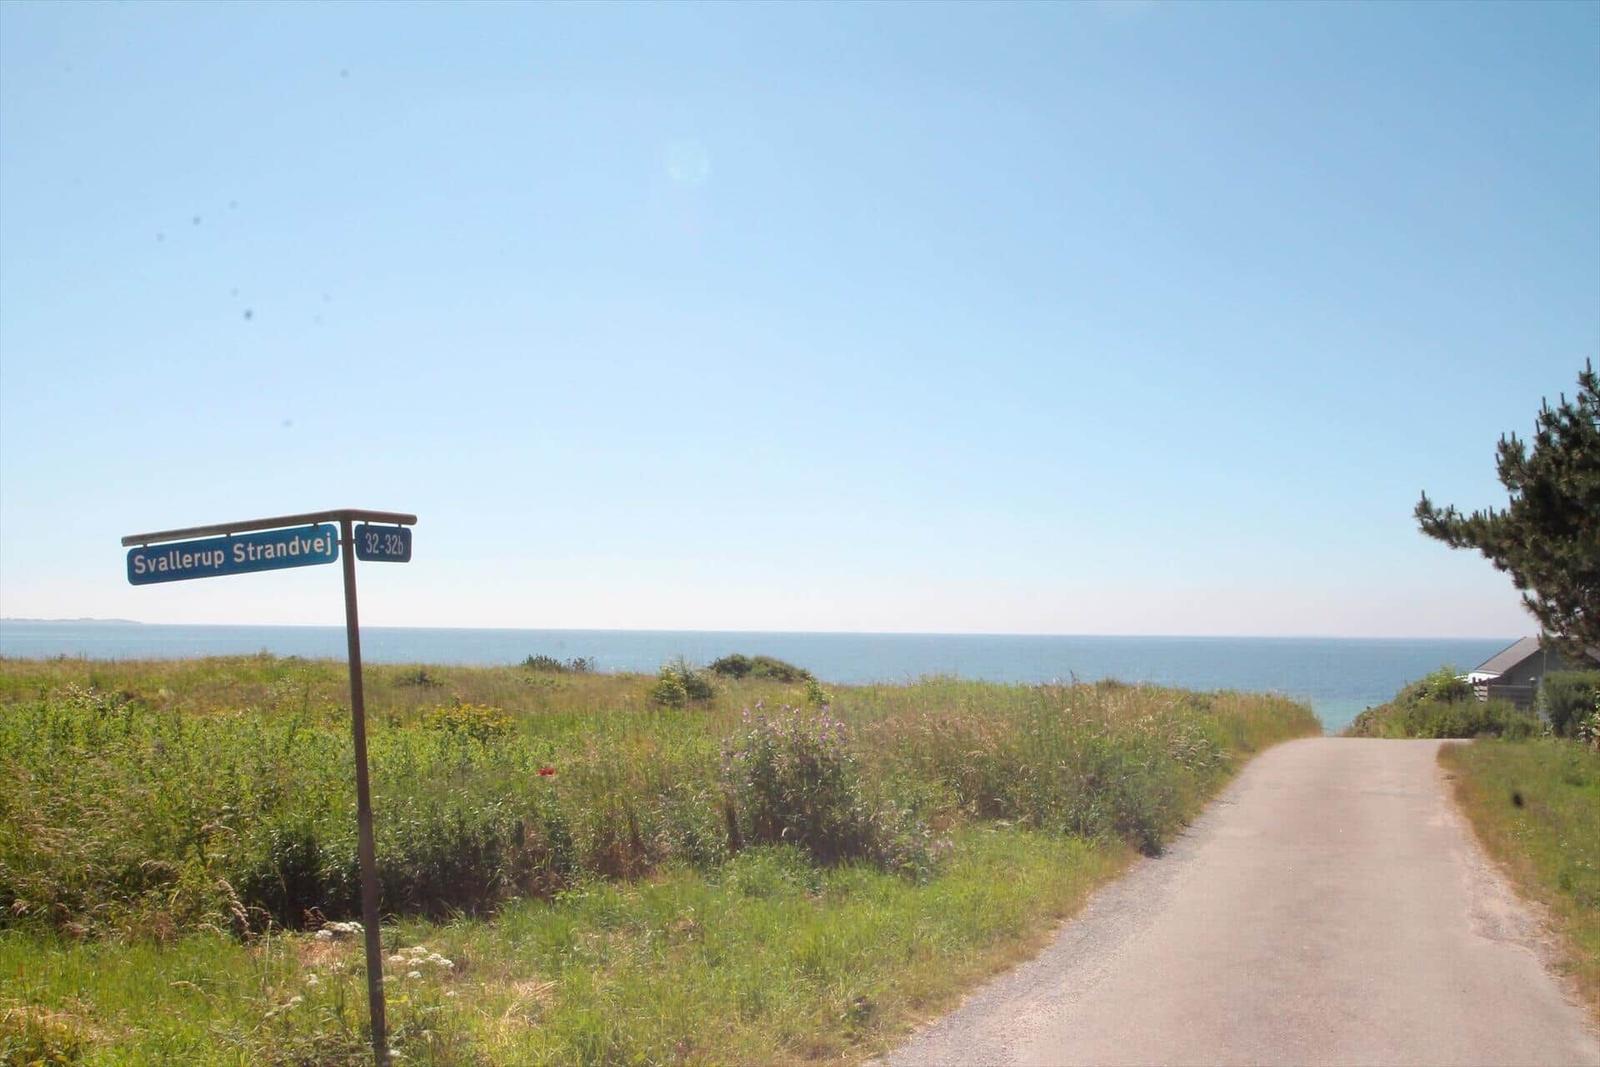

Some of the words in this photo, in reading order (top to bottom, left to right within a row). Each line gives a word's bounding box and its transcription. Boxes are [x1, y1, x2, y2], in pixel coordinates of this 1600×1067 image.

[134, 550, 225, 574] Svallerup
[233, 532, 332, 562] Strandvej
[365, 532, 404, 555] 32-32b
